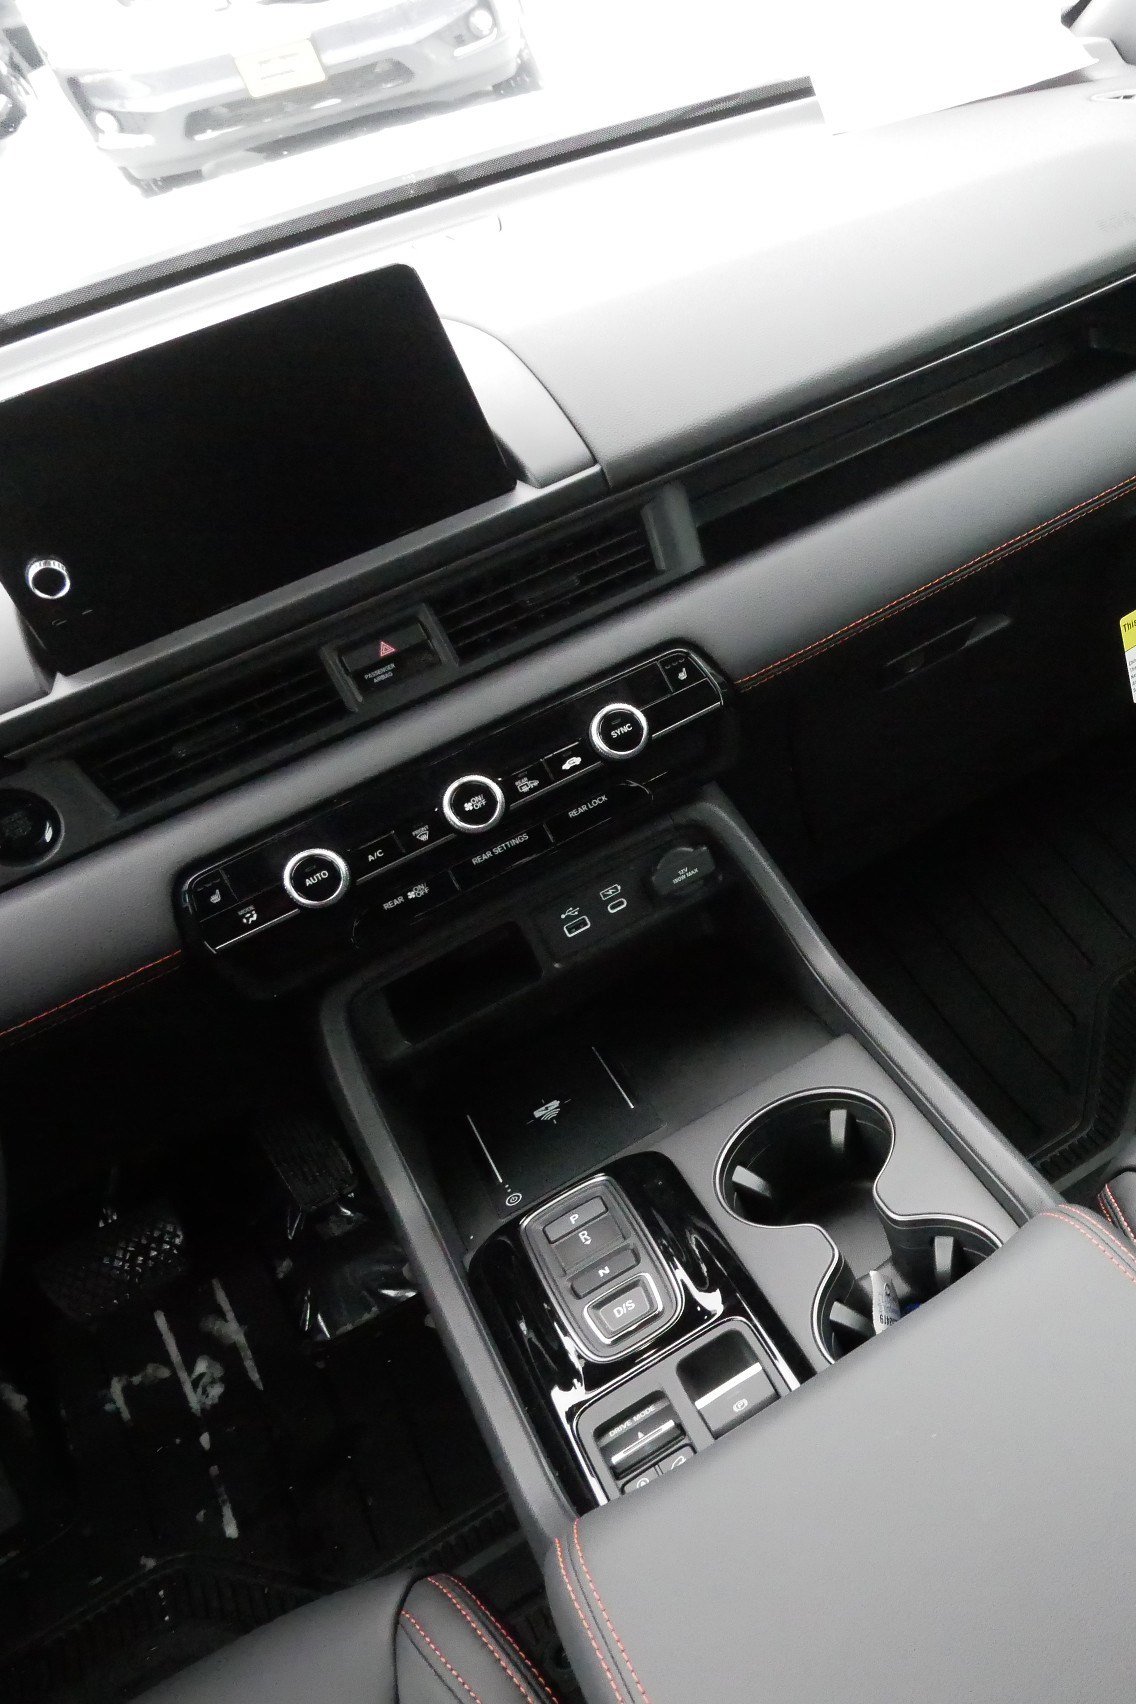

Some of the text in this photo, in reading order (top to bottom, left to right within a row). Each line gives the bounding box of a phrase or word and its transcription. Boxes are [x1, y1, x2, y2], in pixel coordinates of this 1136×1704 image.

[1123, 619, 1136, 632] This
[610, 723, 633, 739] SYNC
[473, 799, 487, 810] OFF
[568, 794, 608, 818] REAR LOCK
[367, 849, 384, 862] A/C
[472, 833, 529, 865] REAR SETTINGS
[305, 870, 329, 887] AUTO
[686, 867, 699, 878] MAX
[415, 887, 430, 898] OFF
[382, 896, 405, 911] REAR
[569, 1213, 579, 1225] P
[579, 1230, 591, 1244] R
[598, 1265, 610, 1278] N
[613, 1299, 636, 1318] D/S
[609, 1404, 656, 1437] DRIVE MODE
